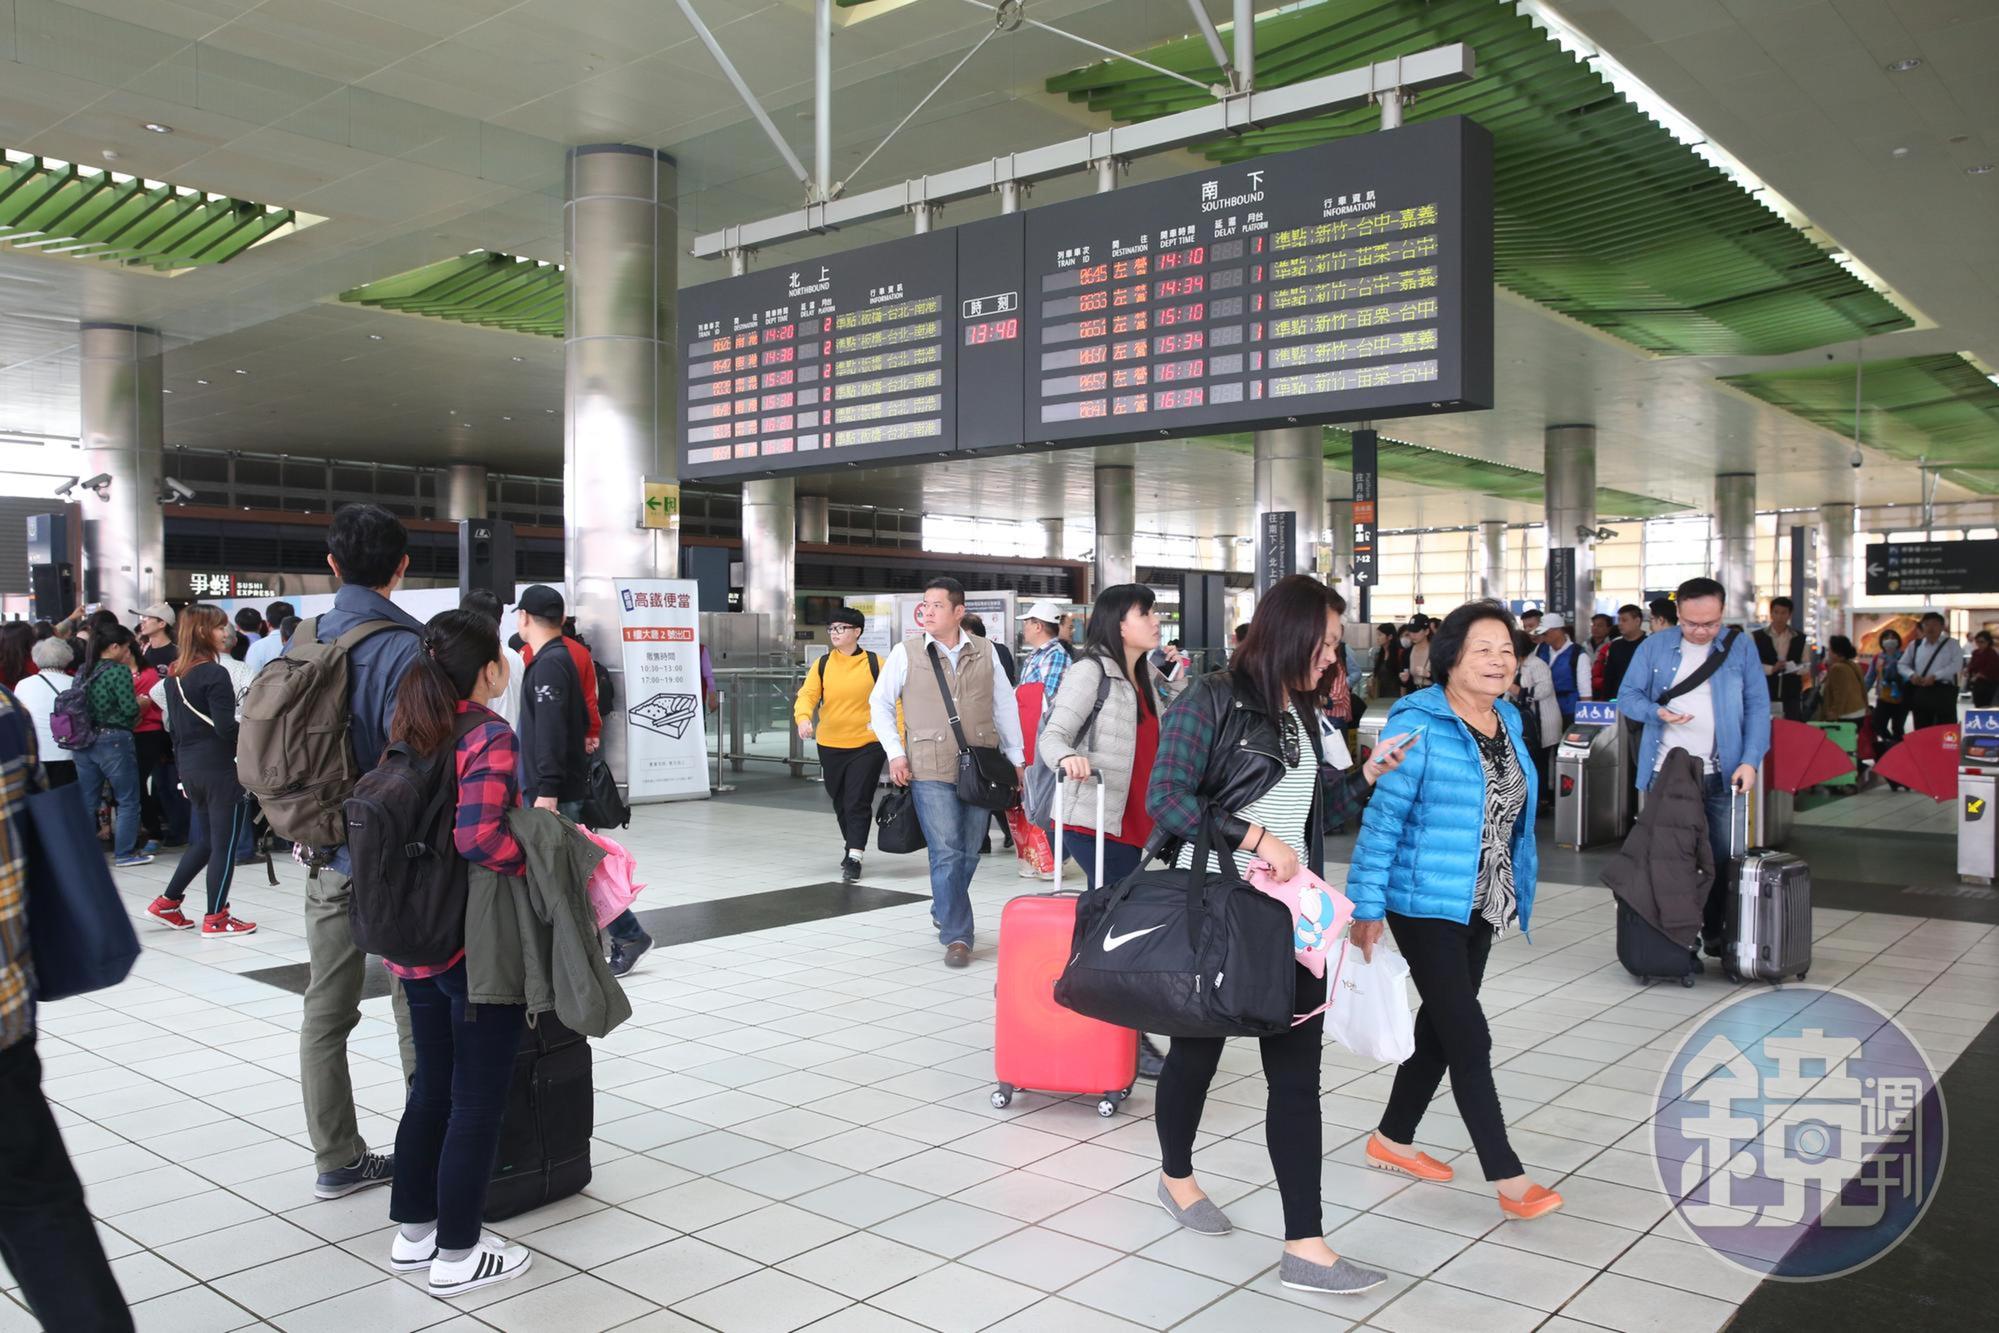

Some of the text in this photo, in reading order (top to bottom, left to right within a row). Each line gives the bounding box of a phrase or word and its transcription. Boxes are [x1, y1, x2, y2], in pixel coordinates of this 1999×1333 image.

[1202, 170, 1264, 202] 南下
[1202, 190, 1264, 213] SOUTHBOUND
[1324, 201, 1376, 218] INFORMATION
[1242, 221, 1268, 233] PLATFORM
[1247, 212, 1263, 223] 月台
[1160, 235, 1195, 248] DEPT TIME
[1214, 226, 1236, 239] DELAY
[1112, 244, 1148, 258] DESTINATION
[1160, 247, 1204, 269] 14:10
[1057, 259, 1075, 267] TRAIN
[789, 265, 830, 288] 北上
[1160, 275, 1204, 296] 14:34
[788, 282, 830, 298] NORTHBOUND
[870, 292, 903, 304] INFORMATION
[800, 310, 815, 318] DELAY
[1160, 304, 1204, 325] 15:10
[765, 324, 794, 341] 14:20
[824, 317, 832, 332] 2
[972, 319, 1017, 343] 13:40
[765, 347, 793, 363] 14:38
[824, 340, 832, 355] 2
[1160, 331, 1204, 353] 15:34
[765, 370, 793, 387] 15:20
[1160, 359, 1204, 381] 16:10
[1160, 387, 1204, 408] 16:34
[1356, 554, 1370, 563] 7-12
[190, 573, 230, 595] 爭鮮
[634, 592, 690, 608] 高鐵便當
